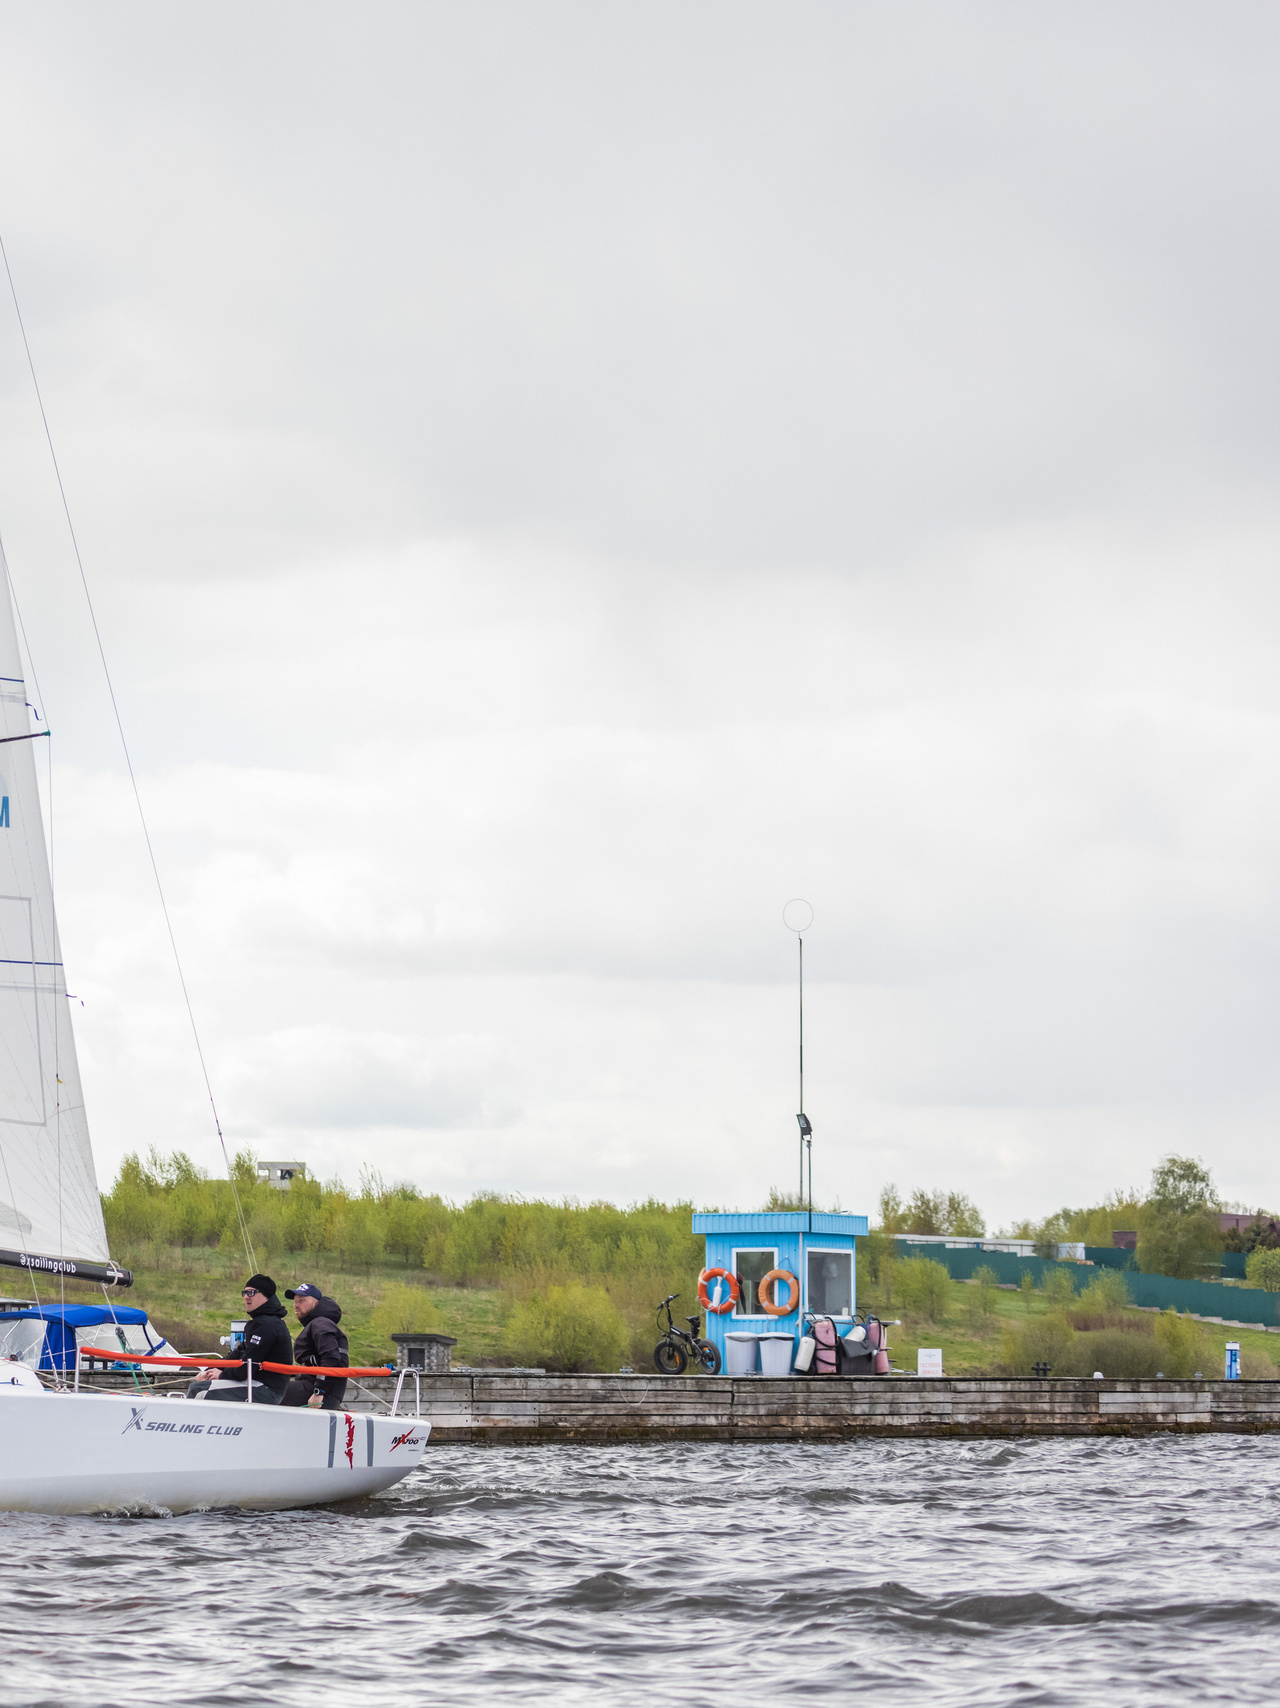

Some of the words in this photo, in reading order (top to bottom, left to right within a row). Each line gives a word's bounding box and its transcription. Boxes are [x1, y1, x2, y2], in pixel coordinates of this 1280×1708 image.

[20, 1253, 77, 1274] @xsailingclub
[145, 1421, 205, 1434] SAILING
[207, 1425, 243, 1436] CLUB
